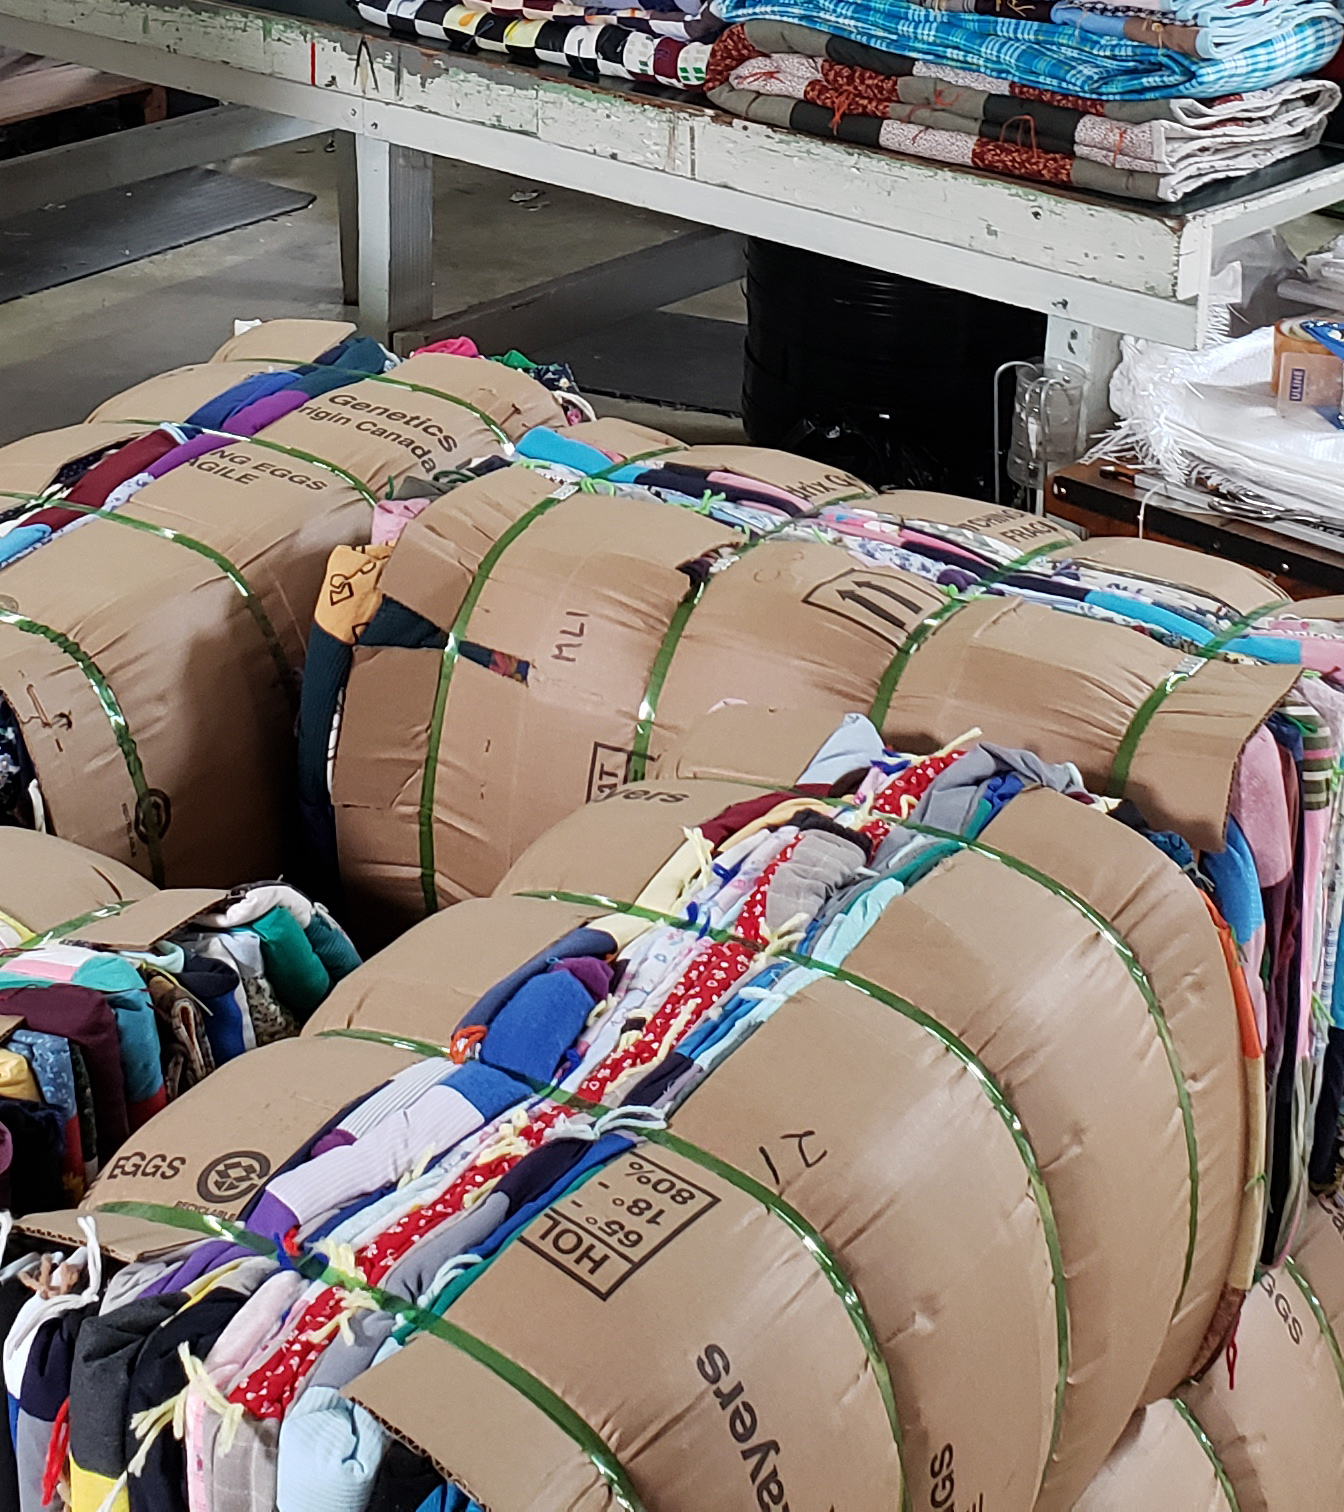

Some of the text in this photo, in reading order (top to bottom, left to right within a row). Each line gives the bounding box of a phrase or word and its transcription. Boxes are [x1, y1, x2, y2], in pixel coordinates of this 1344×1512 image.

[296, 403, 438, 474] rigin Canada
[327, 393, 458, 454] Genetics
[251, 456, 329, 492] EGGS
[106, 1151, 187, 1181] EGGS
[624, 1159, 697, 1207] 80%
[536, 1211, 611, 1276] HOL
[695, 1343, 791, 1512] ayers
[929, 1442, 955, 1512] GS
